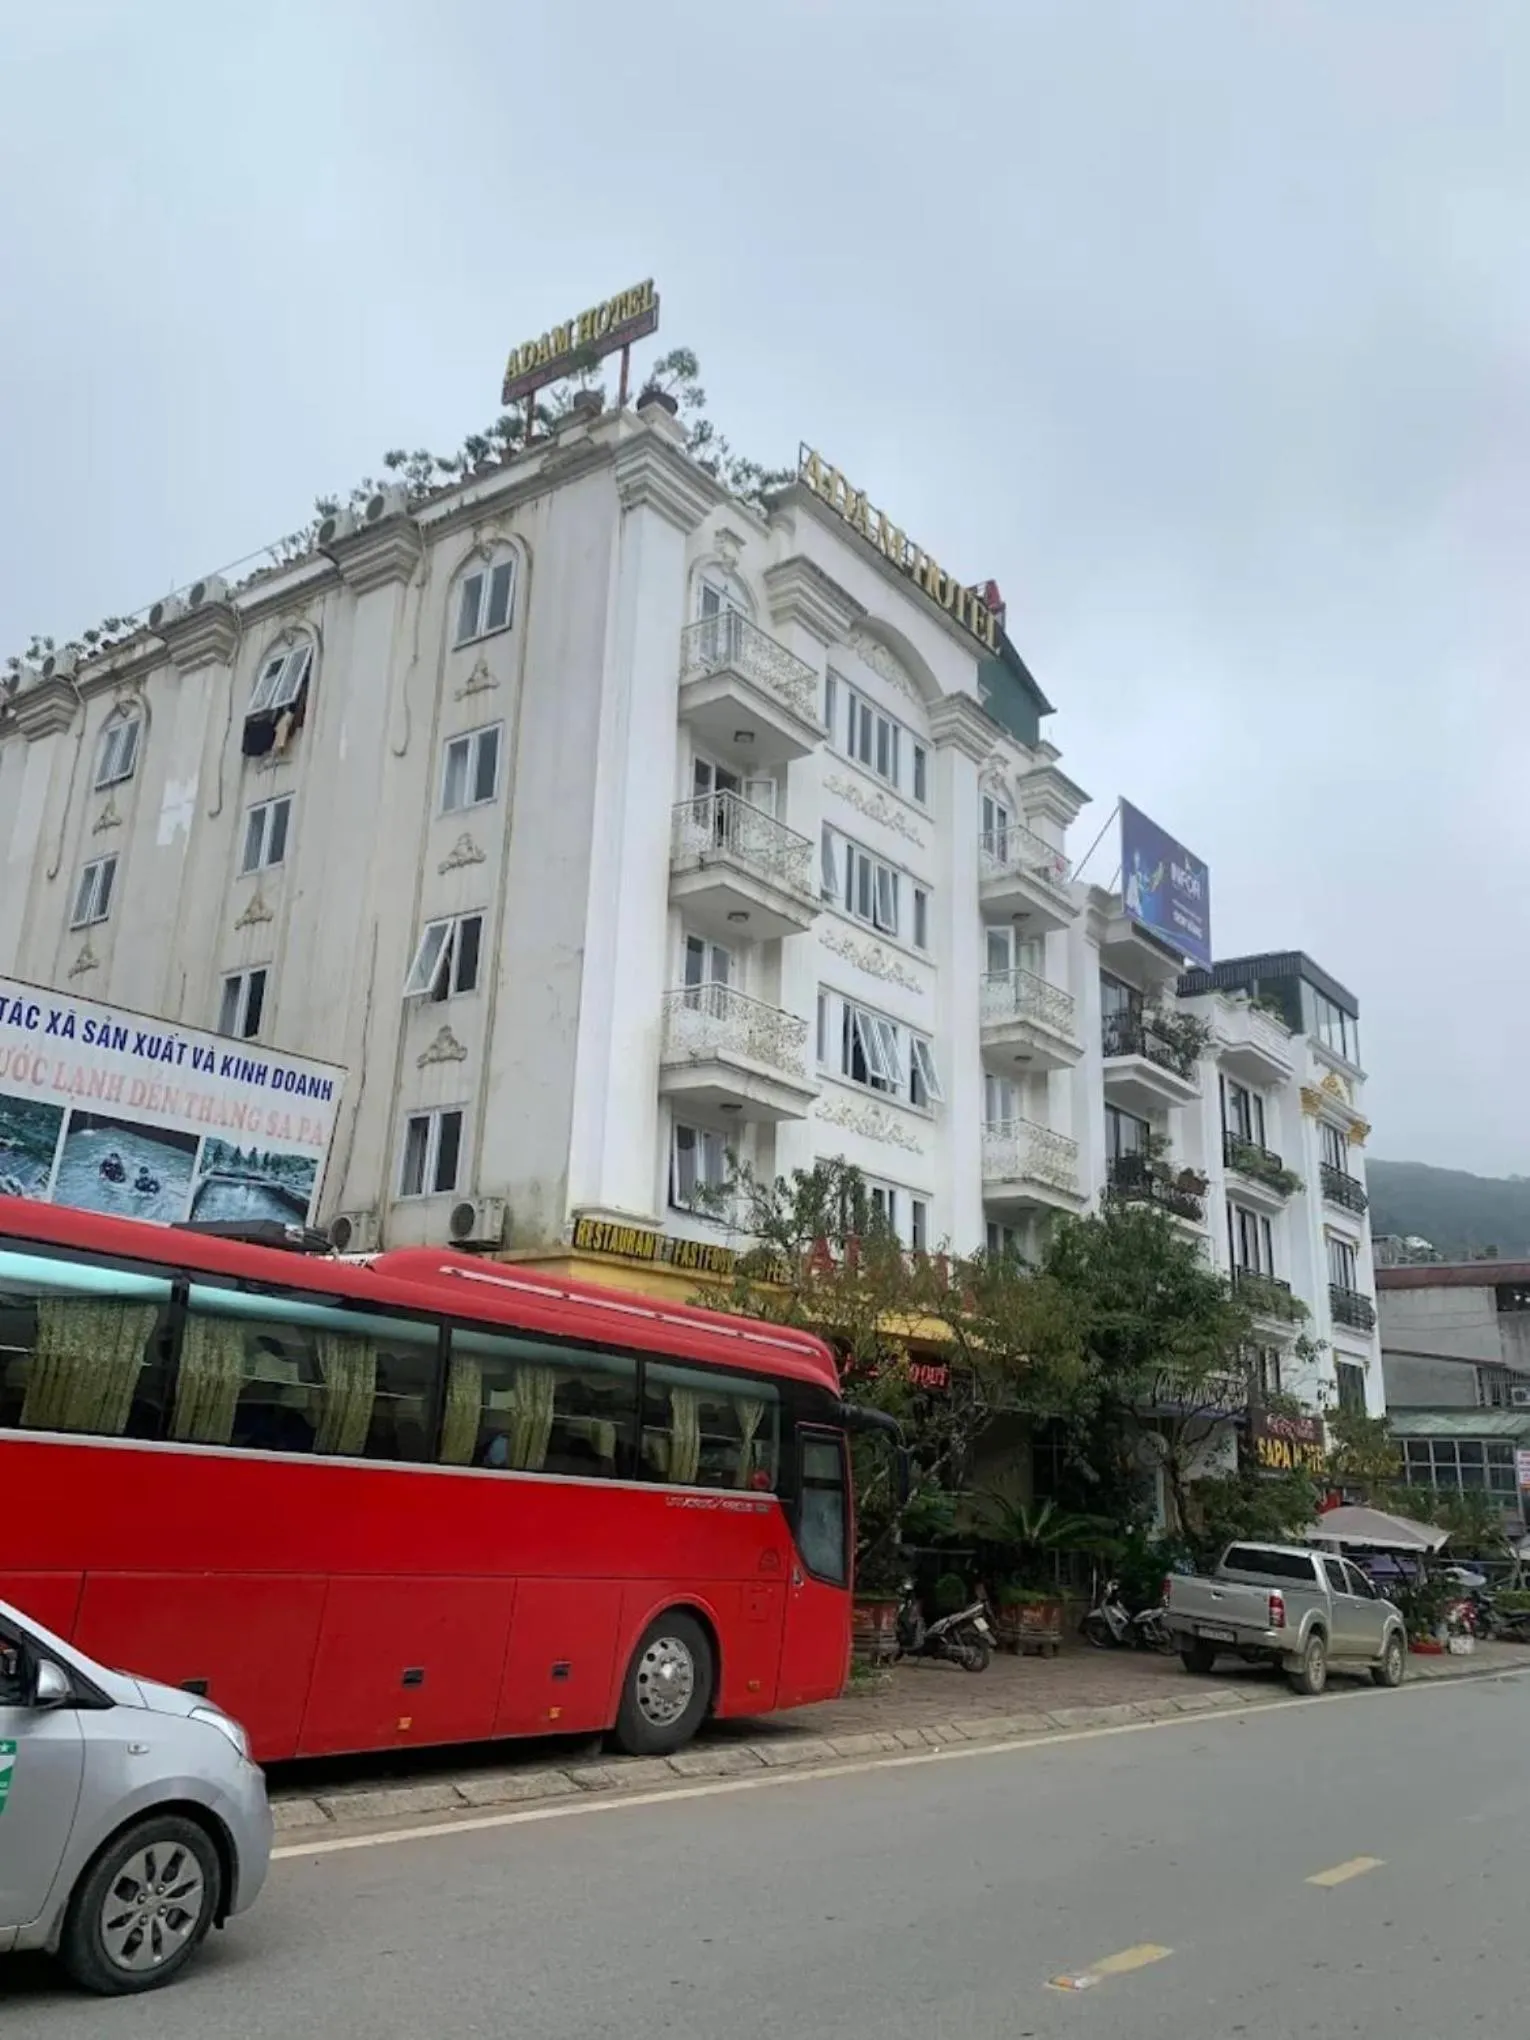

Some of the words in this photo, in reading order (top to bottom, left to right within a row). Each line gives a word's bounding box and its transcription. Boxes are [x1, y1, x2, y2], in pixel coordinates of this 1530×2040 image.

[506, 319, 574, 378] ADAM
[576, 278, 655, 343] HOTEL
[806, 452, 906, 566] ADAM
[45, 1009, 77, 1040] XÃ
[82, 1015, 129, 1051] SẢN
[132, 1032, 188, 1066] XUẤT
[192, 1045, 216, 1074] VÀ
[220, 1055, 268, 1086] KINH
[271, 1068, 334, 1102] DOANH
[265, 1110, 292, 1140] SA
[296, 1117, 324, 1146] PA
[576, 1219, 665, 1261] RESTAURANT
